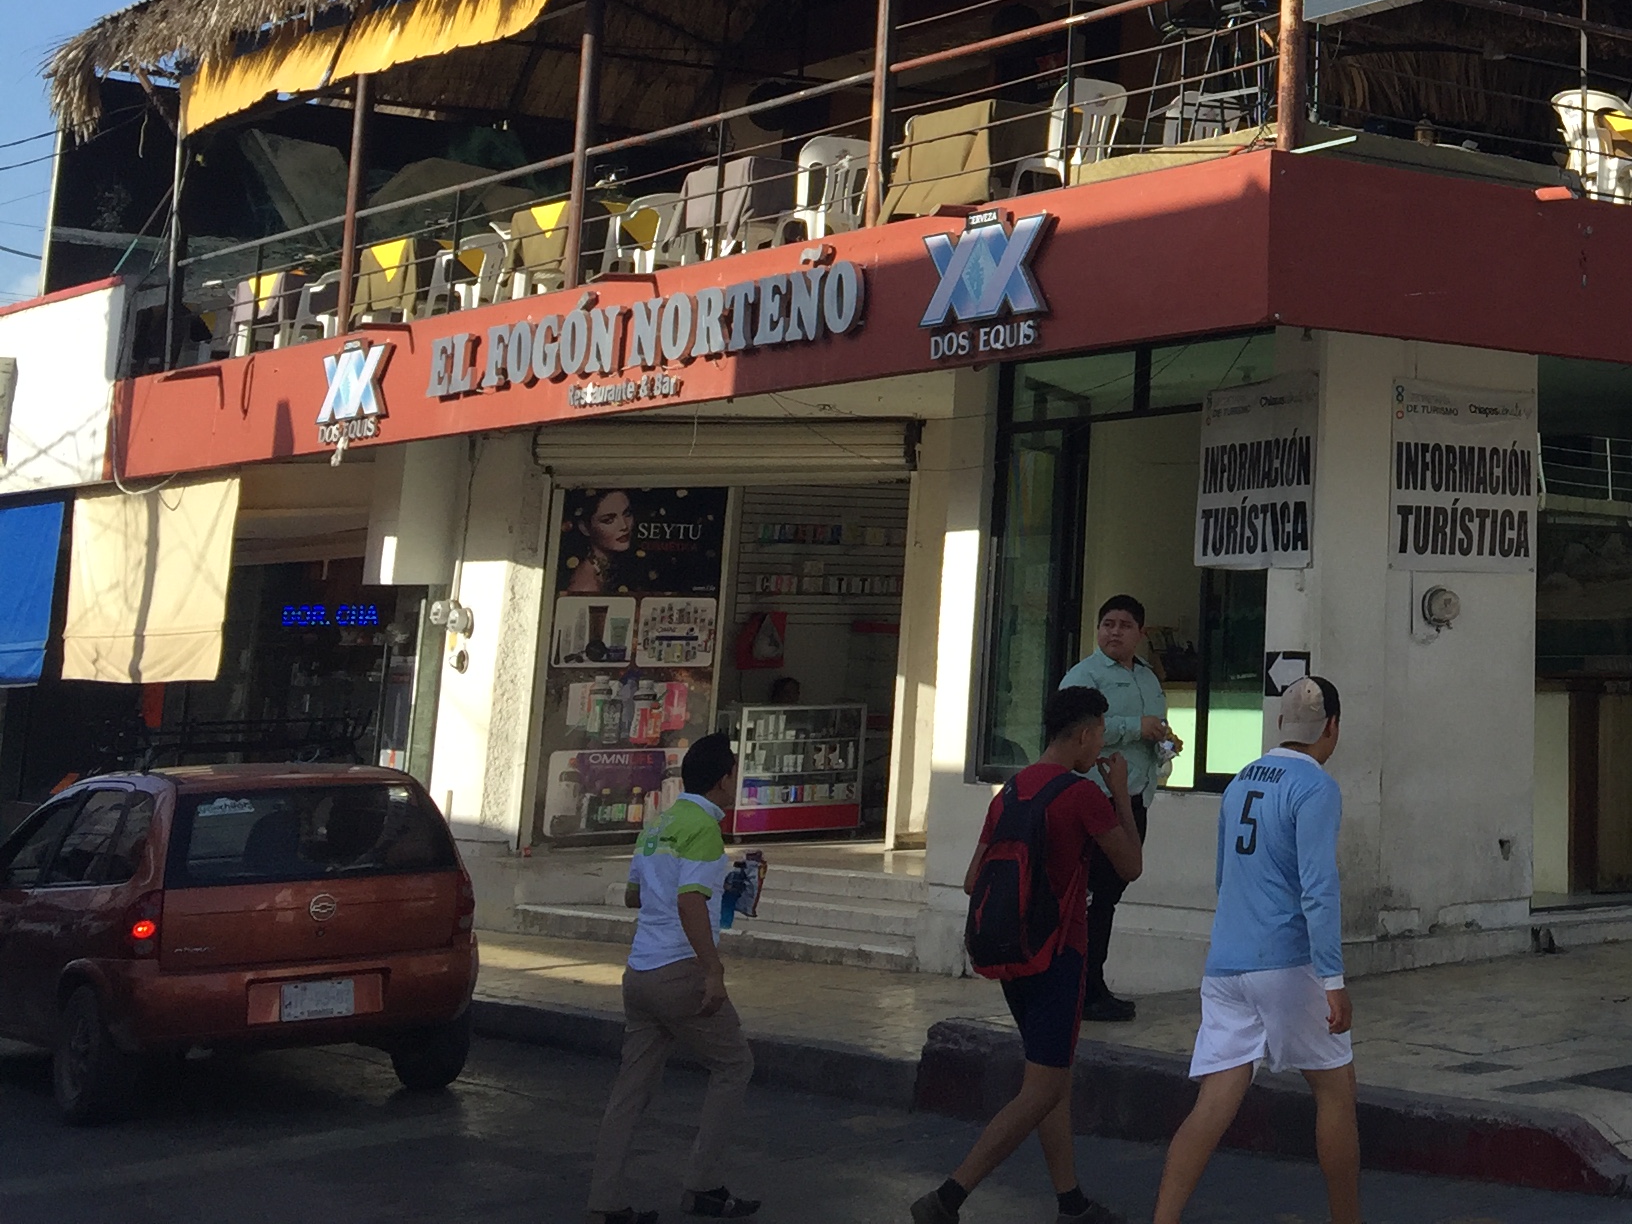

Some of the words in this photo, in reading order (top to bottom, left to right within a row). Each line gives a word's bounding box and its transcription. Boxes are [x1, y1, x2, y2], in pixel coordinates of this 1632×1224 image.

[425, 332, 475, 398] EL
[481, 290, 624, 388] FOGÓN
[628, 244, 862, 368] NORTEÑO
[930, 331, 970, 360] DOS
[979, 320, 1035, 352] EQUIS
[568, 378, 636, 408] Restaurante
[654, 373, 678, 397] Bar
[1406, 404, 1418, 413] DE
[1421, 405, 1459, 417] TURISMO
[318, 424, 339, 444] DOS
[341, 419, 376, 439] EQUIS
[1202, 427, 1311, 495] INFORMACIÓN
[1396, 440, 1531, 497] INFORMACIÓN
[1201, 496, 1309, 557] TURÍSTICA
[1396, 497, 1530, 558] TURÍSTICA
[1235, 790, 1265, 855] 5
